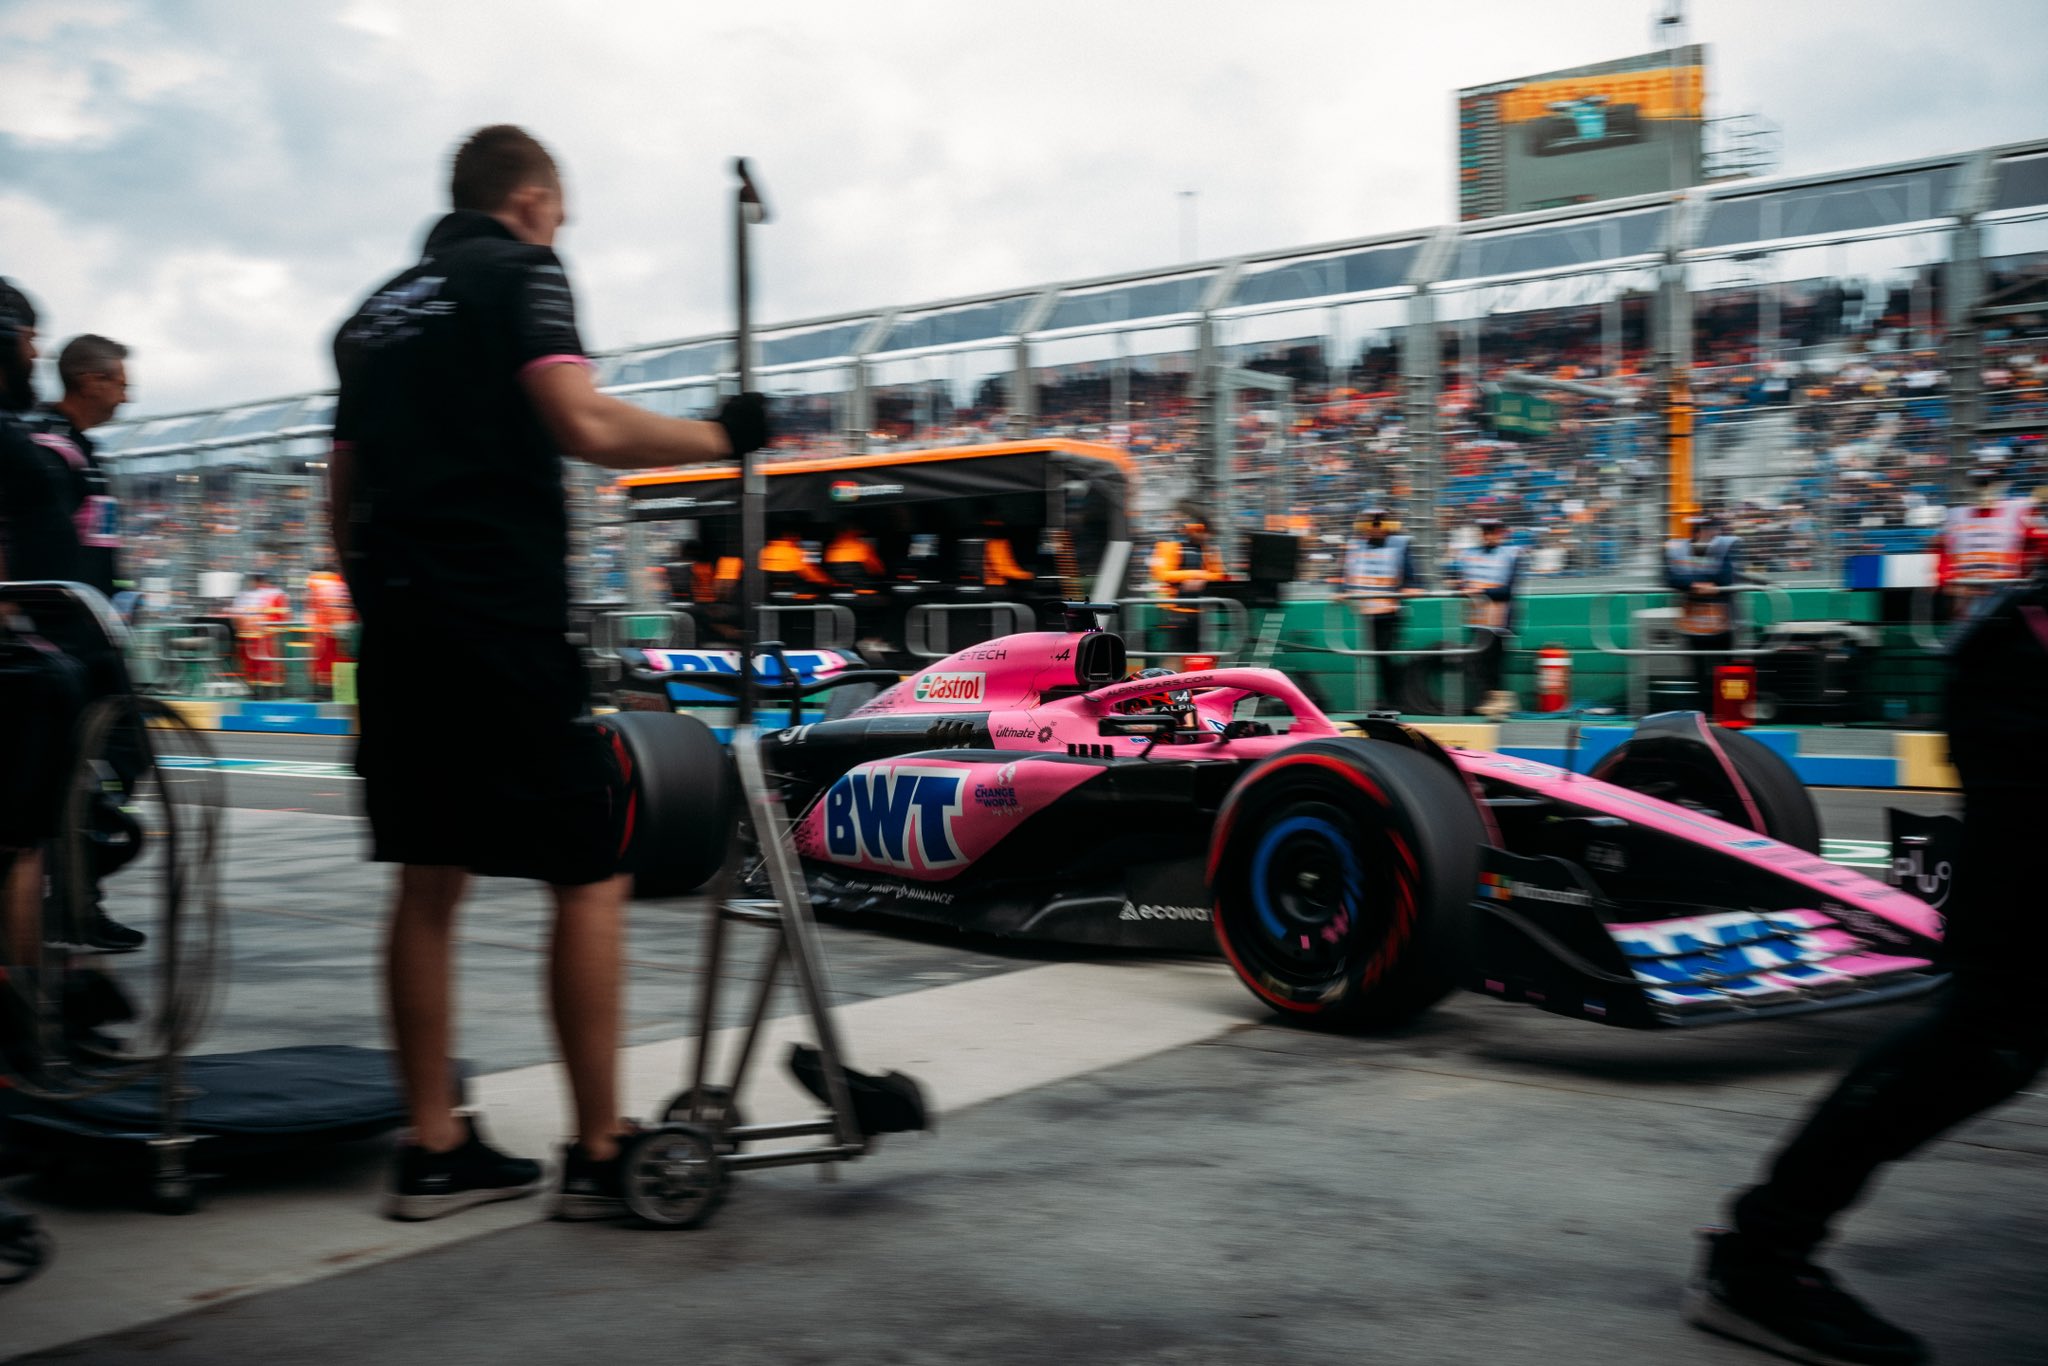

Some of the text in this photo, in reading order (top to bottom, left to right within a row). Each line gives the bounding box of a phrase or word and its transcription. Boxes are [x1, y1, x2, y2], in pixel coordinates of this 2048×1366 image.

[928, 675, 979, 699] Castrol
[1106, 675, 1214, 697] ALPINECARS.COM
[995, 726, 1036, 739] ultimate
[974, 787, 1015, 798] CHANGE
[825, 769, 968, 867] BWT
[907, 887, 955, 904] BINANCE
